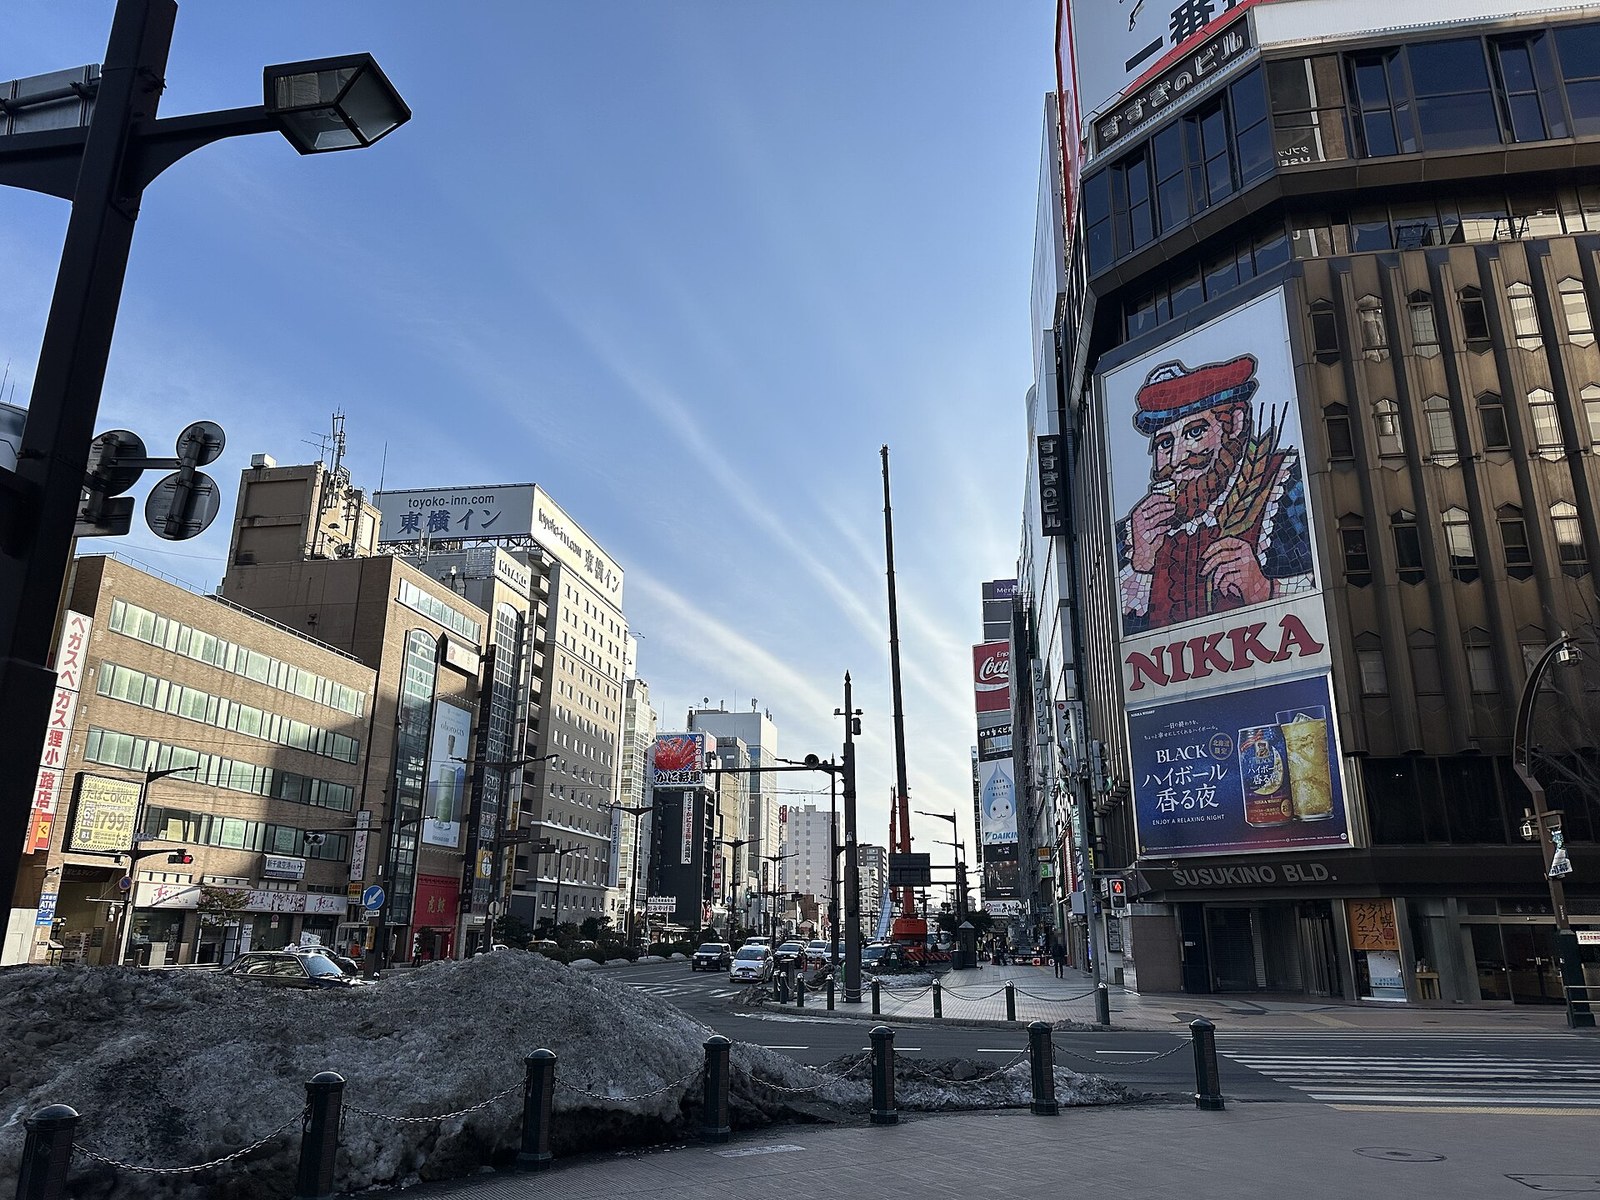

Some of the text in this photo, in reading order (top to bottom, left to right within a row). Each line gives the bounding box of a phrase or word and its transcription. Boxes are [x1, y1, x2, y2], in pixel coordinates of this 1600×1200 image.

[1125, 0, 1238, 73] 一番
[408, 495, 495, 510] toyoko-inn.com
[397, 508, 502, 535] 東横イン
[1125, 614, 1324, 691] NIKKA
[36, 616, 87, 809] ベガスベガス狸小路店
[1156, 744, 1208, 764] BLACK
[1142, 763, 1229, 788] ハイボール
[1155, 783, 1220, 813] 香る夜
[1177, 816, 1205, 824] RELAXING
[1172, 863, 1337, 886] SUSUKINO BLD.
[40, 900, 56, 909] ATM
[1378, 903, 1394, 928] 札幌
[1353, 903, 1369, 945] スクエア
[1367, 903, 1382, 944] タイムズ
